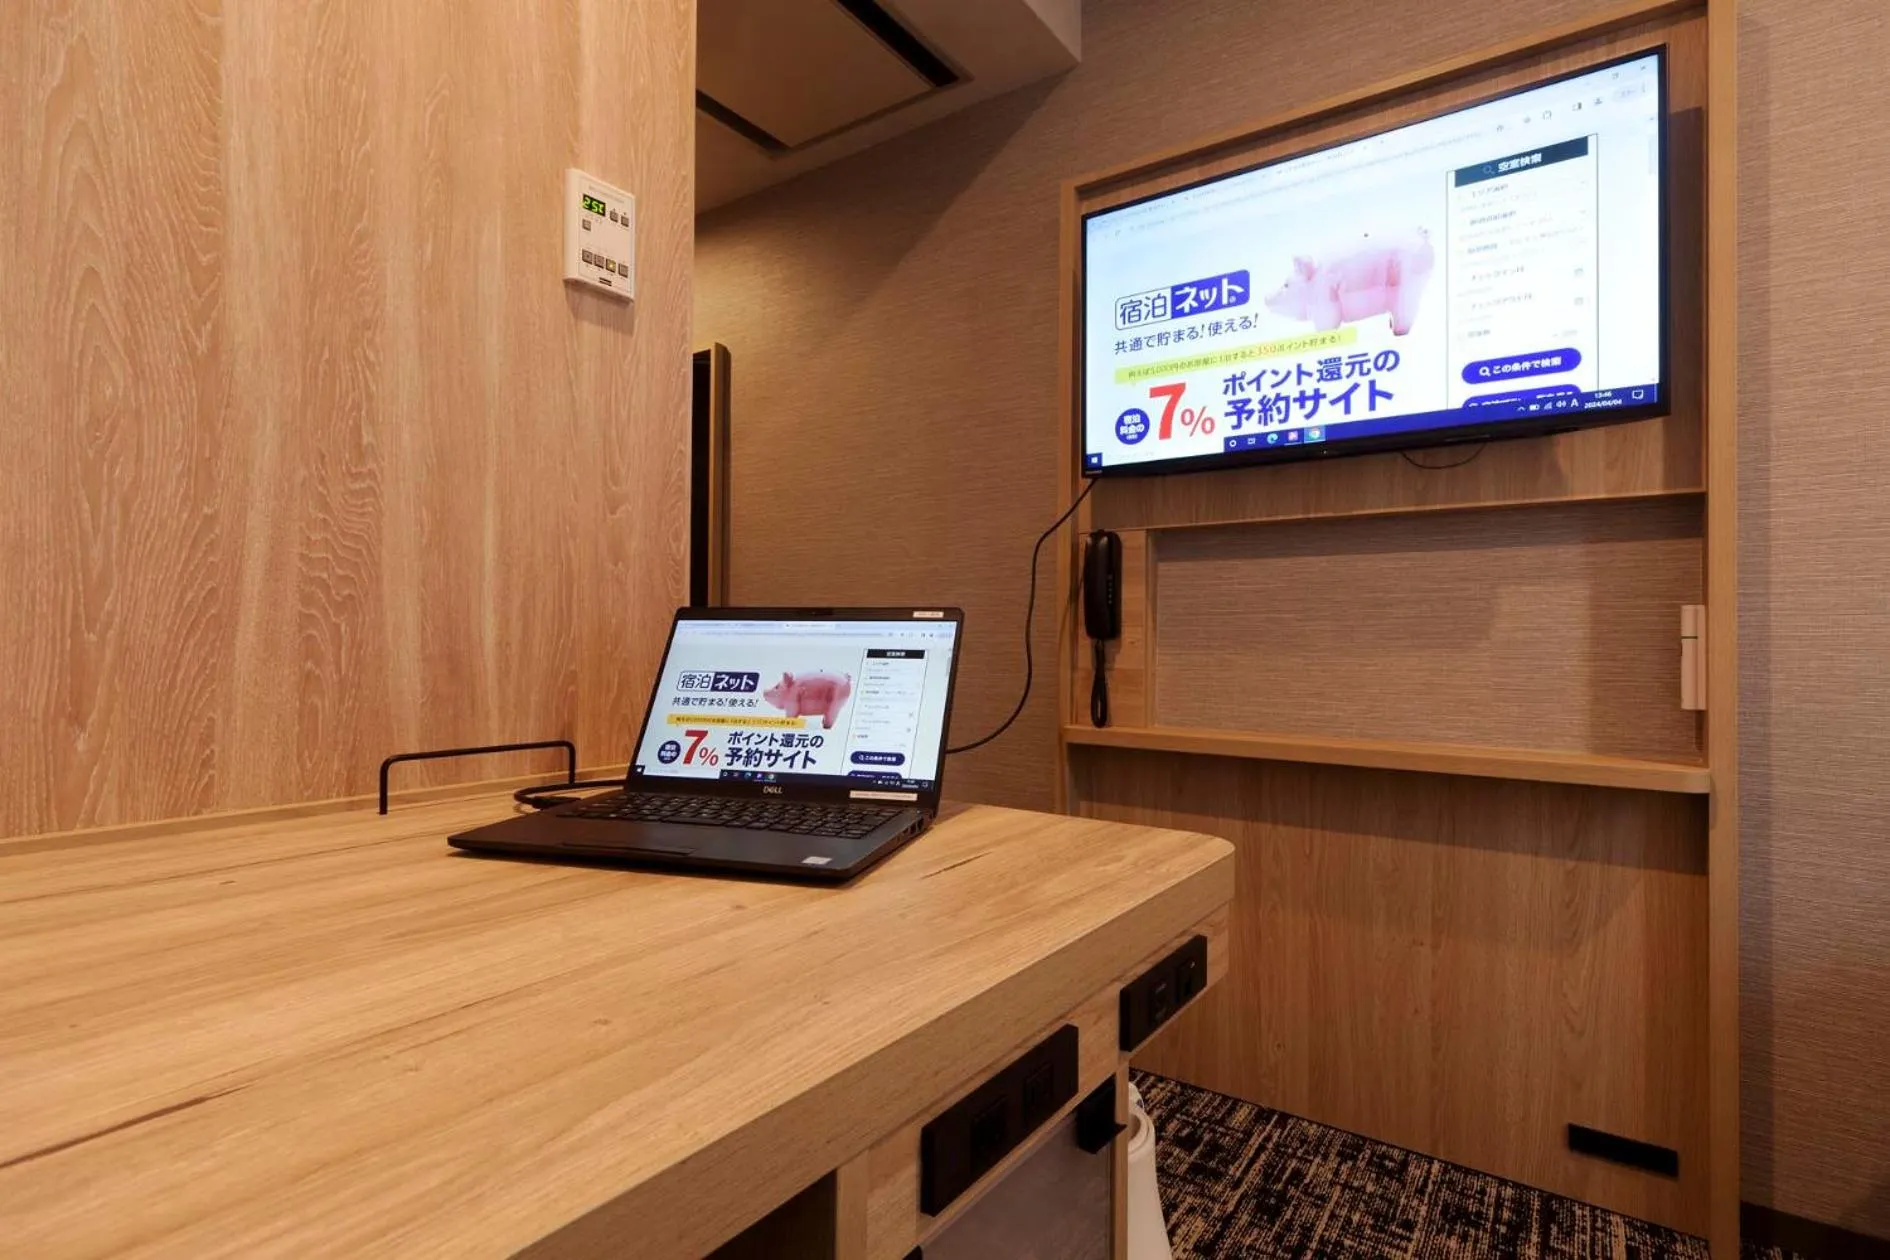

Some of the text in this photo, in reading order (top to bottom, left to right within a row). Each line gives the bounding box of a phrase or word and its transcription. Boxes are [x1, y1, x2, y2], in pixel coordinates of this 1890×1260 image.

[1222, 349, 1400, 396] ポイント還元の
[1224, 379, 1394, 430] 予約サイト
[727, 731, 824, 748] ポイント還元の
[725, 747, 817, 769] 予約サイト
[763, 786, 783, 794] DELL
